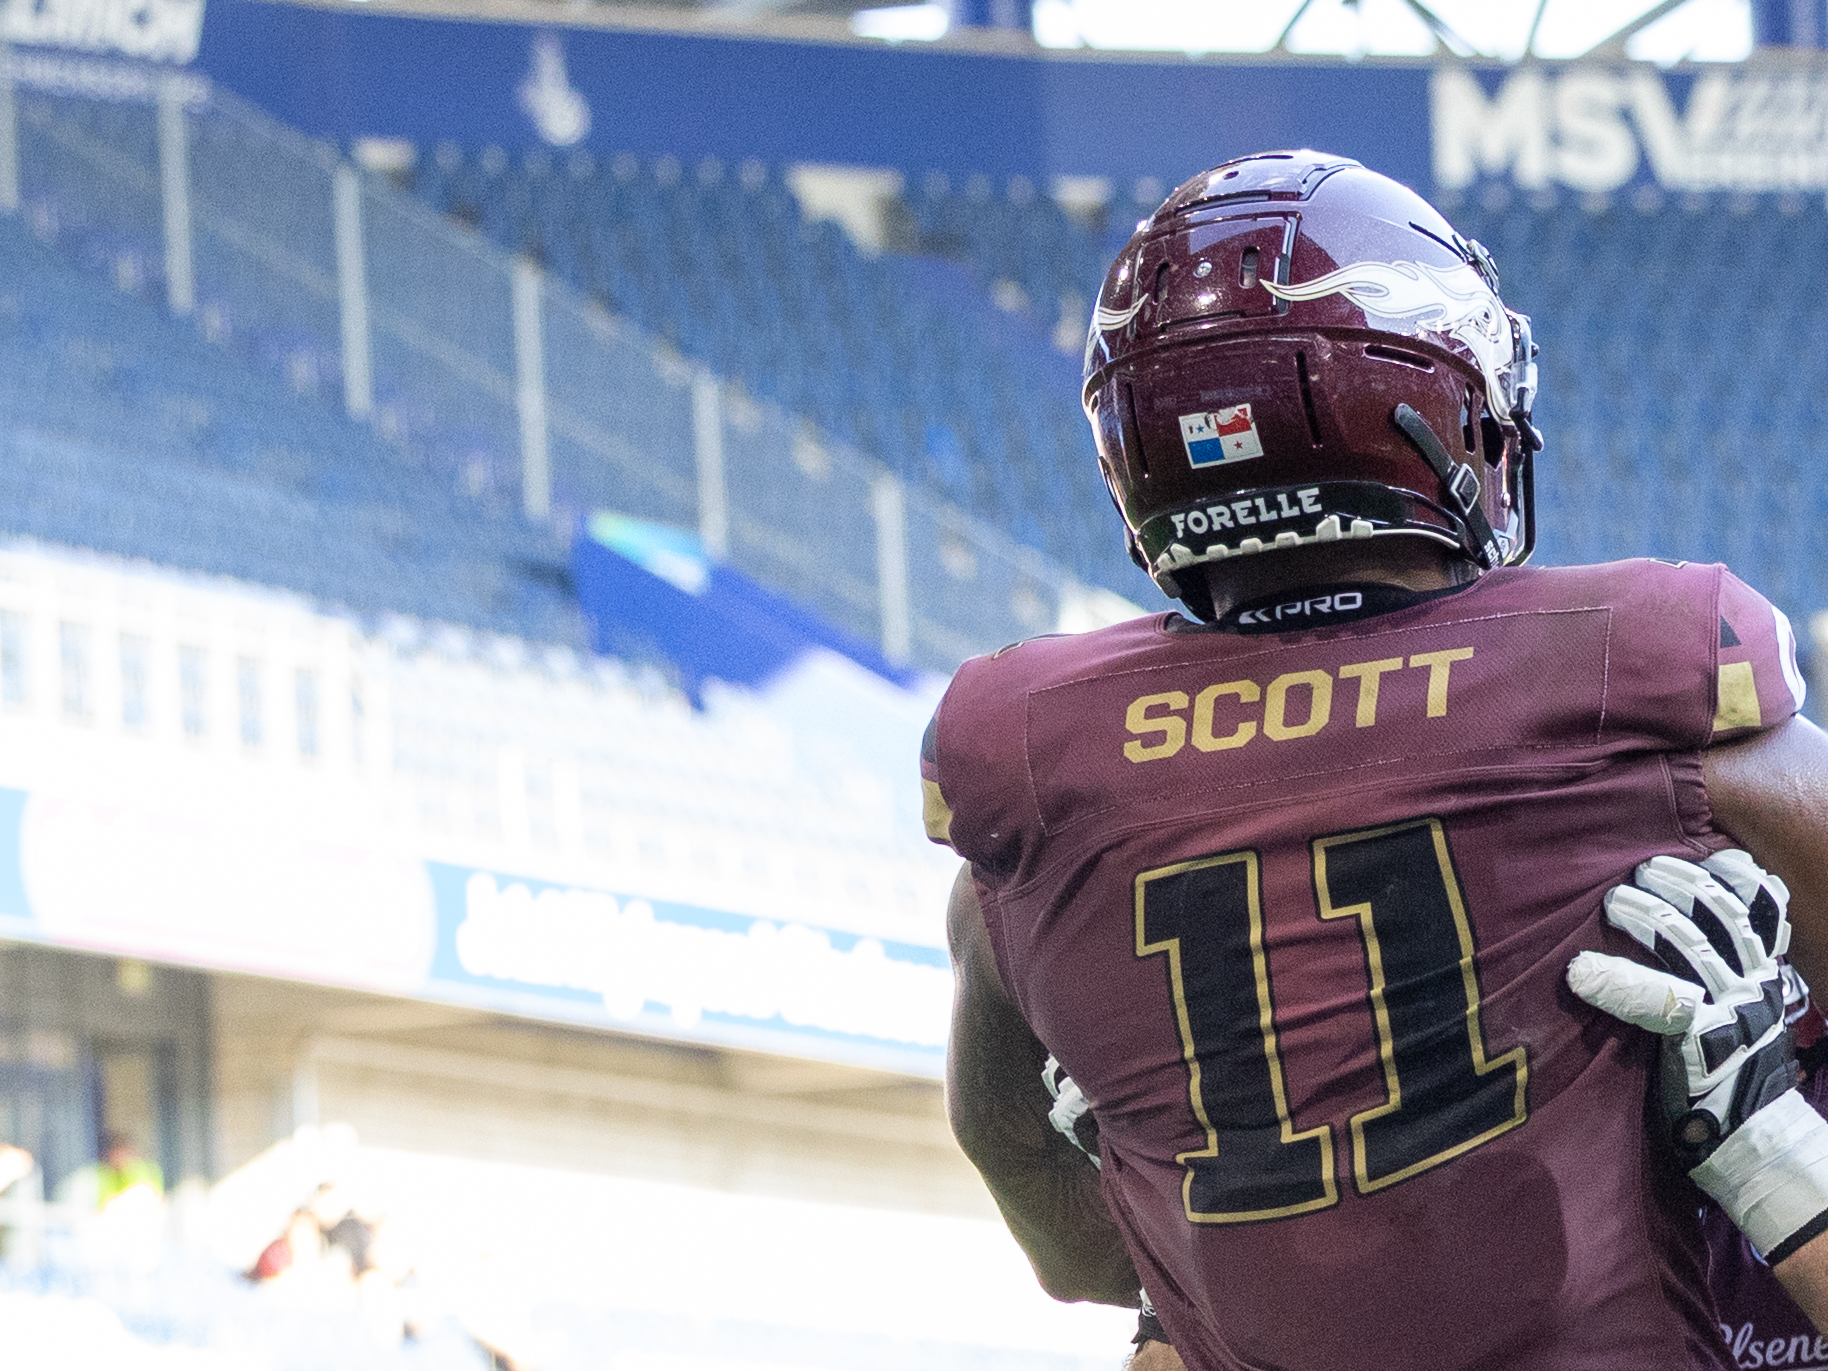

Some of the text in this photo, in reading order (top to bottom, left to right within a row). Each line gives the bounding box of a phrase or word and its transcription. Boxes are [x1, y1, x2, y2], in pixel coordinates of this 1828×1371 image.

[1432, 68, 1730, 192] MSV
[1171, 488, 1322, 539] FORELLE
[1123, 646, 1475, 764] SCOTT
[1134, 816, 1530, 1224] 11
